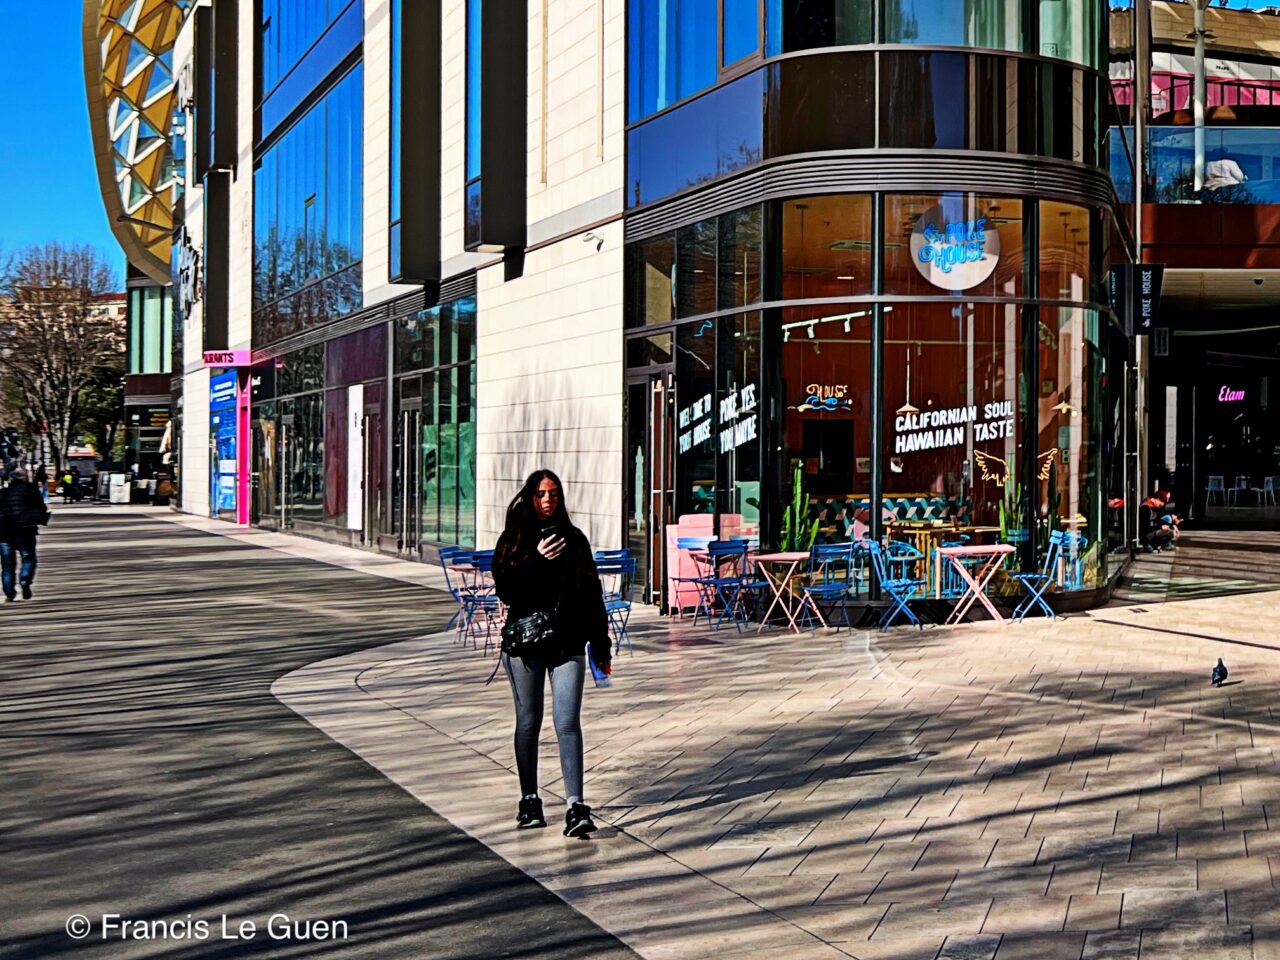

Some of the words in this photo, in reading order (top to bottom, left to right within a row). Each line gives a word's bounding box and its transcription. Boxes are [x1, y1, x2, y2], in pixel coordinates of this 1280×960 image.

[918, 241, 986, 273] HOUSE
[1142, 270, 1152, 295] HOUSE
[1142, 298, 1152, 317] POKE
[1218, 385, 1246, 402] Etam
[895, 406, 977, 432] CALIFORNIAN
[984, 401, 1014, 419] SOUL
[693, 418, 711, 447] HOUSE
[895, 427, 964, 453] HAWAIIAN
[974, 419, 1014, 442] TASTE
